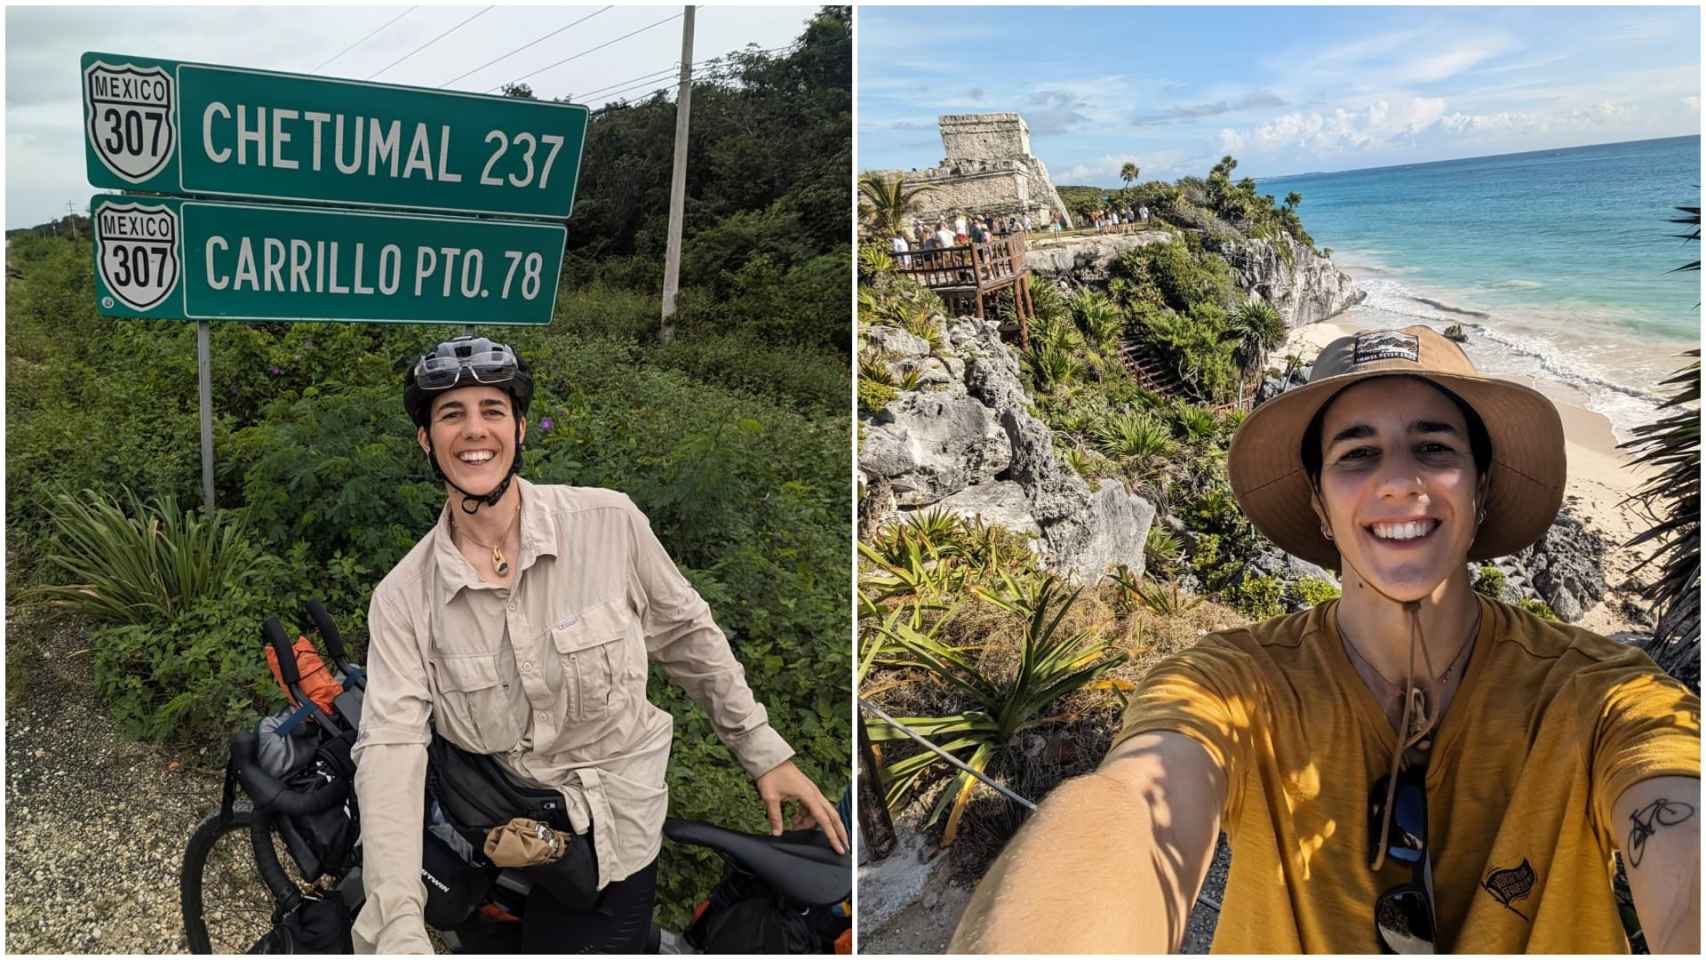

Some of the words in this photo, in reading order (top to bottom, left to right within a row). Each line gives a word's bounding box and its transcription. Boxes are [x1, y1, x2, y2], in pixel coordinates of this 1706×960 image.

[94, 75, 165, 102] MEXICO
[104, 108, 163, 158] 307
[202, 101, 462, 183] CHETUMAL
[479, 129, 565, 189] 237
[103, 212, 170, 238] MEXICO
[113, 245, 167, 288] 307
[205, 234, 402, 296] CARRILLO
[414, 246, 490, 299] PTO.
[501, 249, 544, 300] 78
